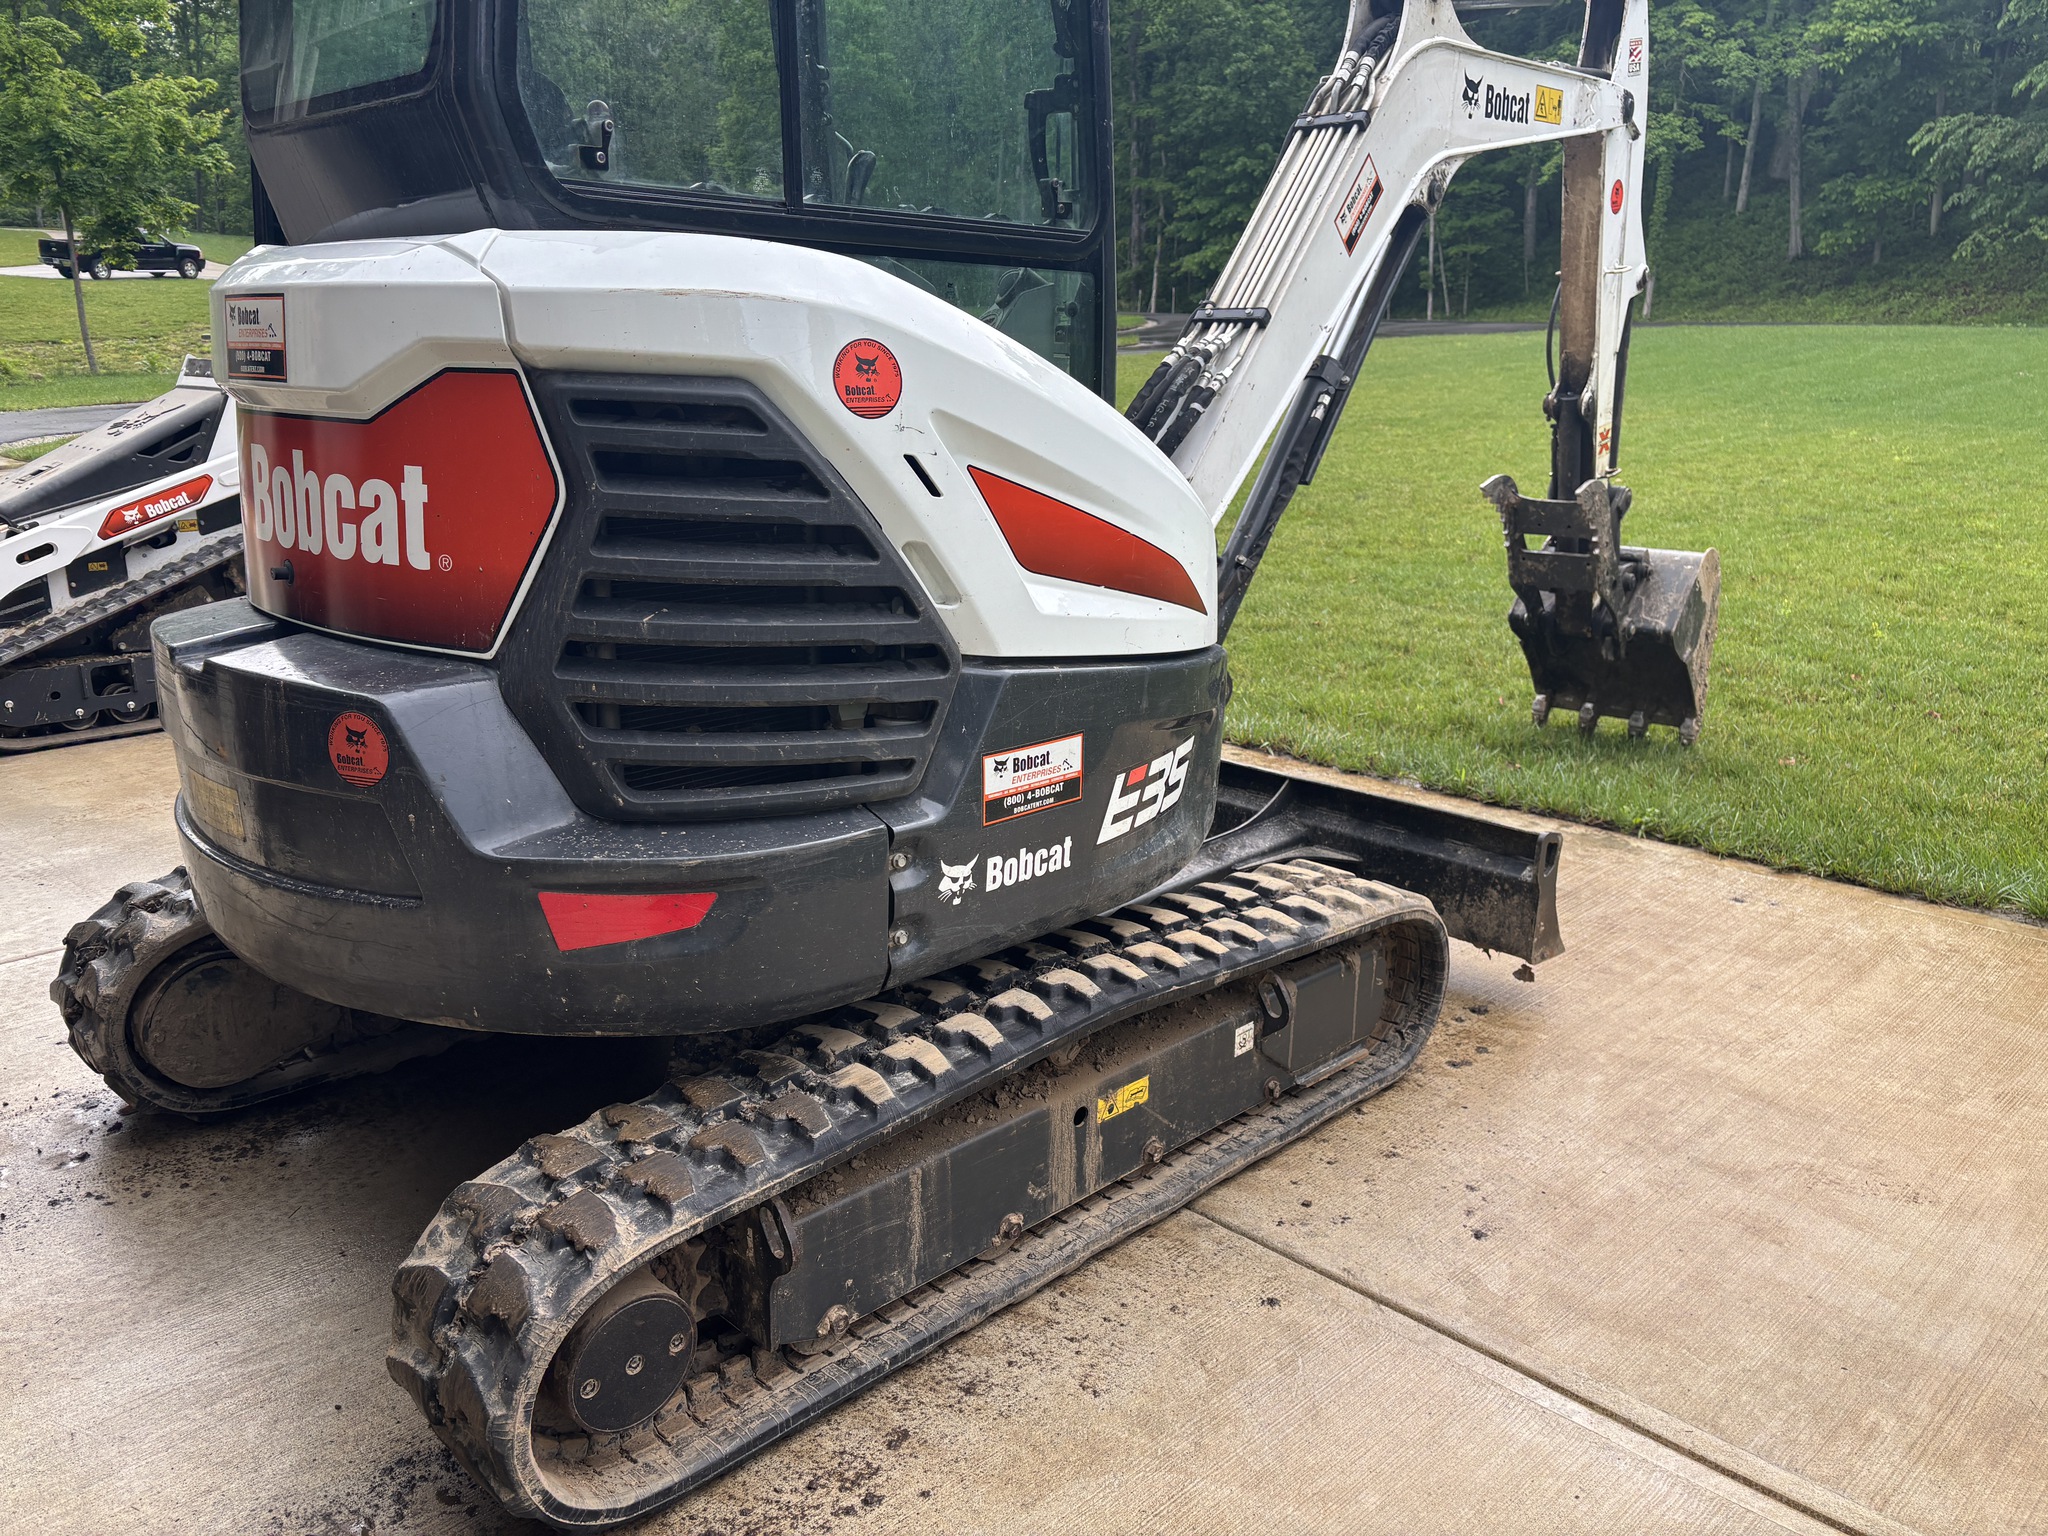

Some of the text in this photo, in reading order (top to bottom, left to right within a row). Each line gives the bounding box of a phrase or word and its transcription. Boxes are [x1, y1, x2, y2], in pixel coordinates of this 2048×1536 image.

[1485, 84, 1530, 124] Bobcat
[1346, 183, 1362, 214] Bobcat
[238, 306, 260, 325] Bobcat
[835, 348, 850, 379] WORKING
[850, 341, 862, 351] FOR
[864, 341, 876, 349] YOU
[876, 345, 893, 361] SINCE
[845, 385, 875, 396] Bobcat
[144, 491, 191, 518] Bobcat
[250, 443, 431, 571] Bobcat
[329, 719, 342, 746] WORKING
[353, 714, 366, 722] YOU
[366, 719, 381, 736] SINCE
[336, 753, 364, 766] Bobcat
[337, 765, 373, 774] ENTERPRISES
[1012, 750, 1051, 774] Bobcat
[1011, 765, 1062, 785] ENTERPRISES
[1003, 793, 1025, 809] (800)
[1026, 782, 1064, 800] 4-BOBCAT
[1096, 735, 1195, 845] E35
[1013, 797, 1055, 814] BOBCATENT.COM
[986, 835, 1073, 893] Bobcat
